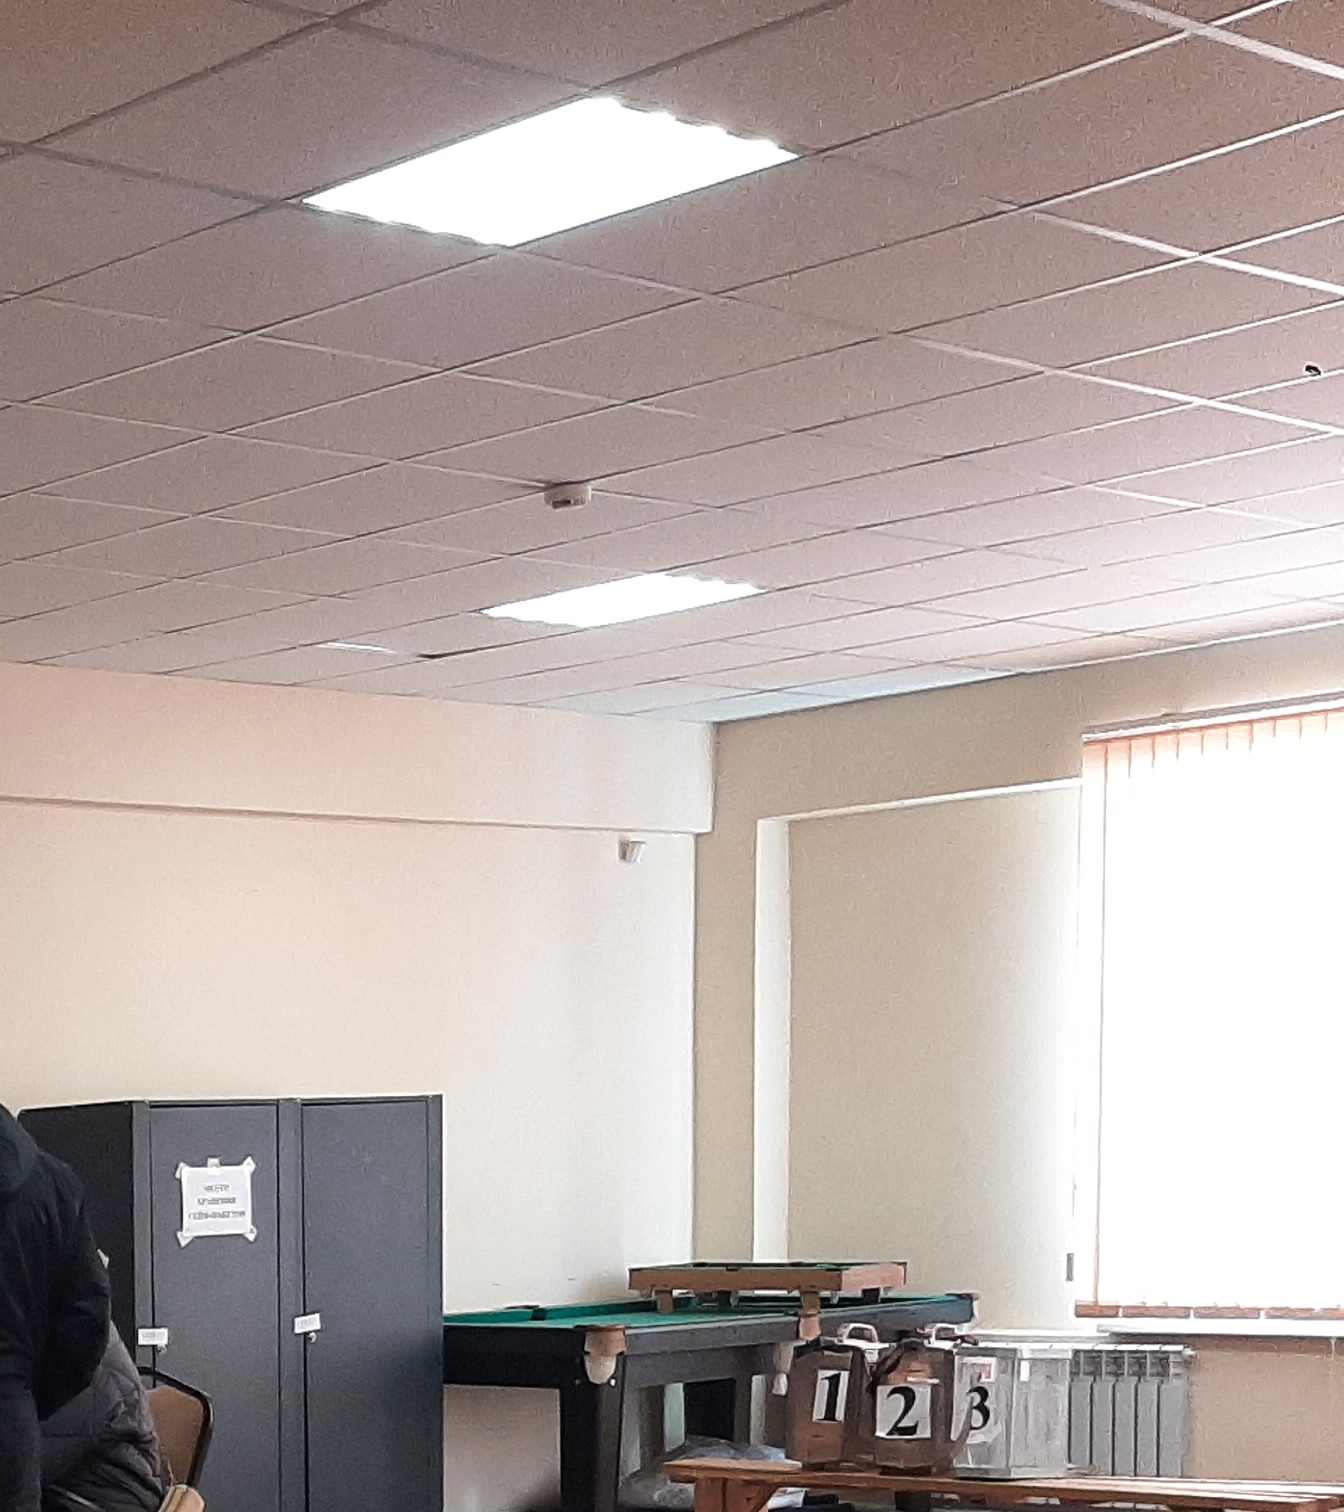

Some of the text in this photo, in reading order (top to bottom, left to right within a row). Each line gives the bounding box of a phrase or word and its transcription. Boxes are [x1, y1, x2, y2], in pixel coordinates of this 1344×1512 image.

[817, 1372, 841, 1421] 1
[886, 1385, 920, 1436] 2
[967, 1386, 991, 1430] 3
